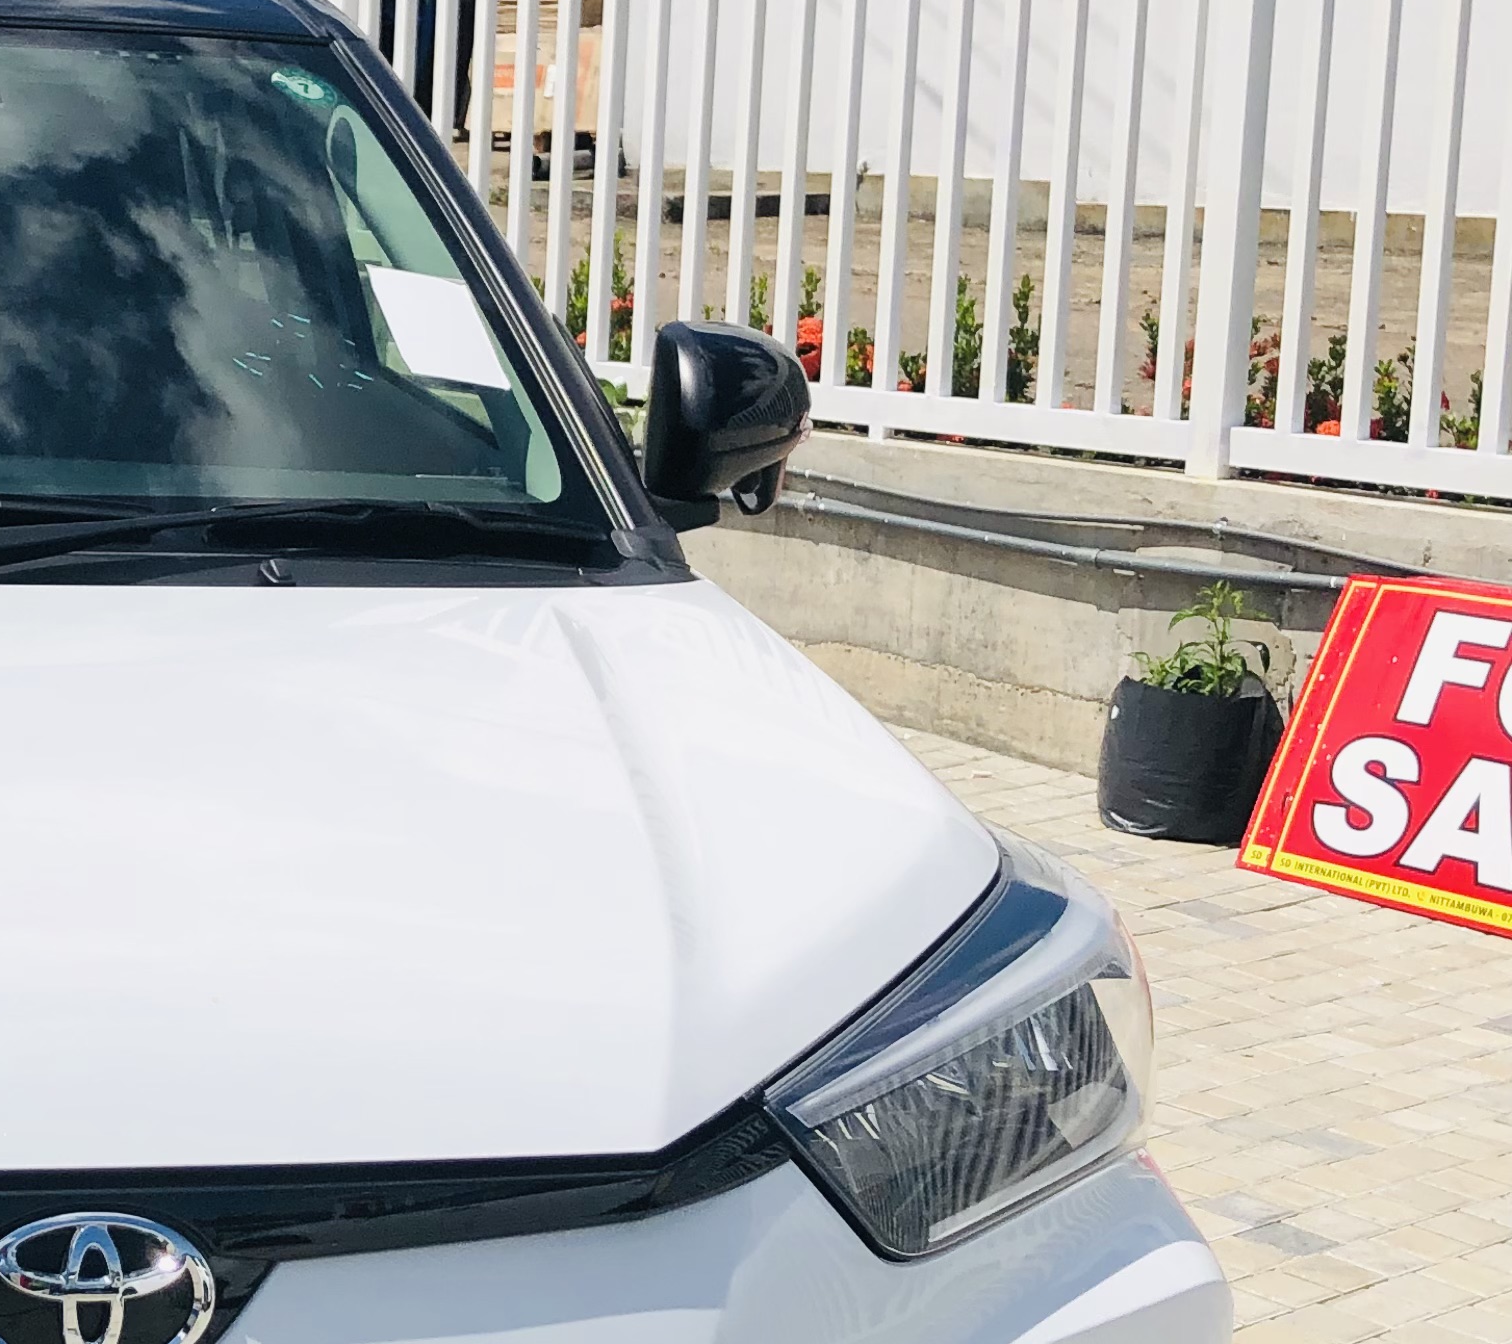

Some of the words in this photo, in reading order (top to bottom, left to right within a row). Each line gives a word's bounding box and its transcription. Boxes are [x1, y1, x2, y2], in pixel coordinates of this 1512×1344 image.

[1280, 857, 1292, 868] SD
[1294, 861, 1363, 886] INTERNATIONAL
[1364, 878, 1391, 895] (PVT)
[1429, 894, 1494, 919] NITTAMBUWA
